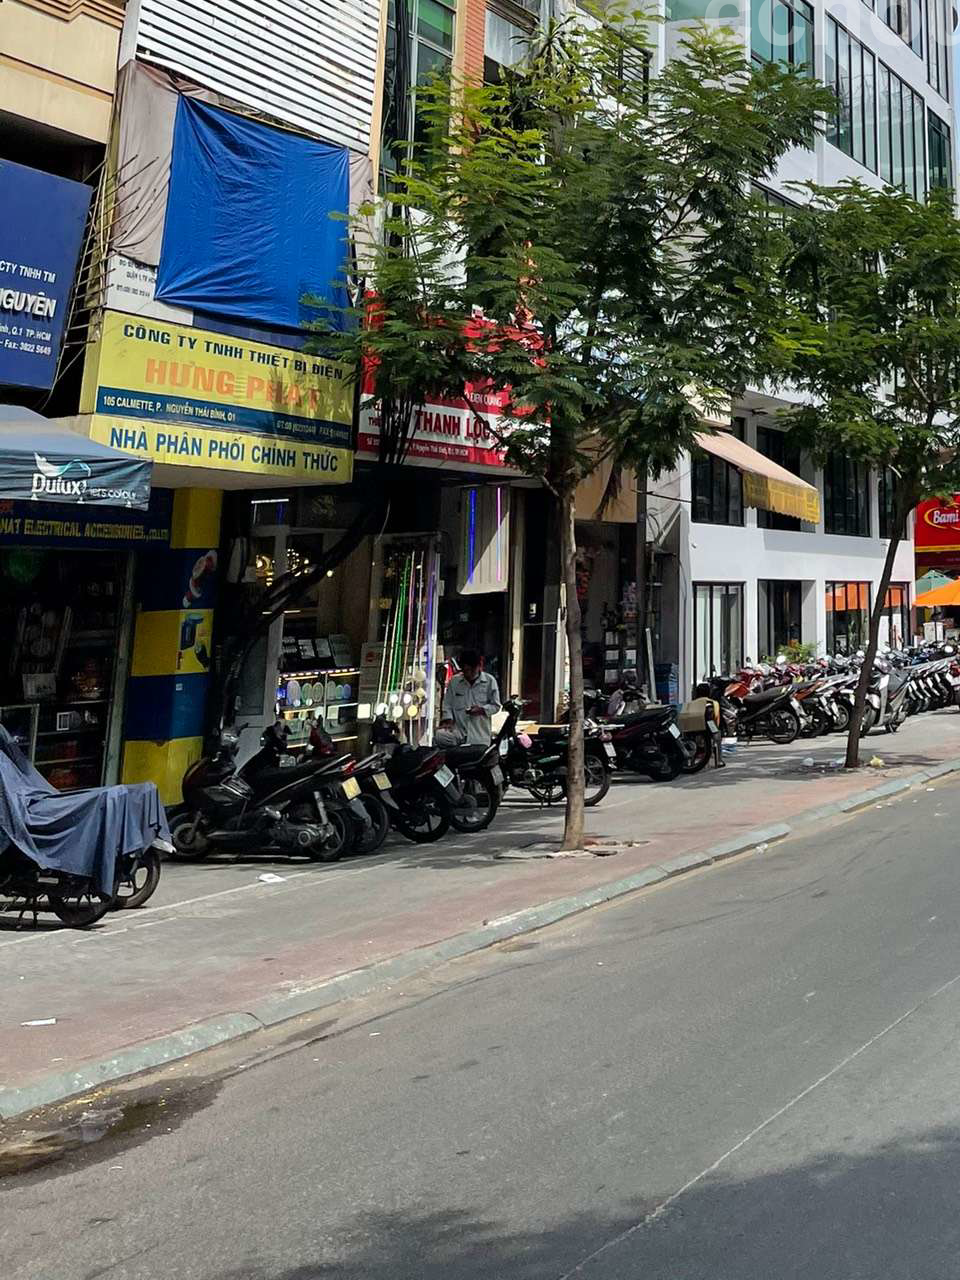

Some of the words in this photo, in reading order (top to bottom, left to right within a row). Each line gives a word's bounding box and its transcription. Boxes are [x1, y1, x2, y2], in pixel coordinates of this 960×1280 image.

[19, 265, 42, 280] TNHH
[43, 270, 56, 284] TM
[123, 324, 171, 345] CÔNG
[177, 335, 199, 350] TY
[204, 340, 243, 359] TNHH
[249, 350, 289, 369] THIẾT
[294, 360, 307, 375] BỊ
[312, 363, 343, 380] ĐIỆN
[145, 357, 235, 396] HƯNG
[103, 395, 116, 407] 105
[116, 397, 155, 412] CALMETTE,
[156, 403, 163, 412] P.
[415, 409, 460, 436] THANH
[110, 426, 148, 451] NHÀ
[156, 431, 203, 457] PHÂN
[208, 435, 245, 462] PHỐI
[251, 442, 296, 468] CHÍNH
[302, 449, 339, 472] THỨC
[24, 519, 81, 537] ELECTRICAL
[933, 509, 960, 524] Bami
